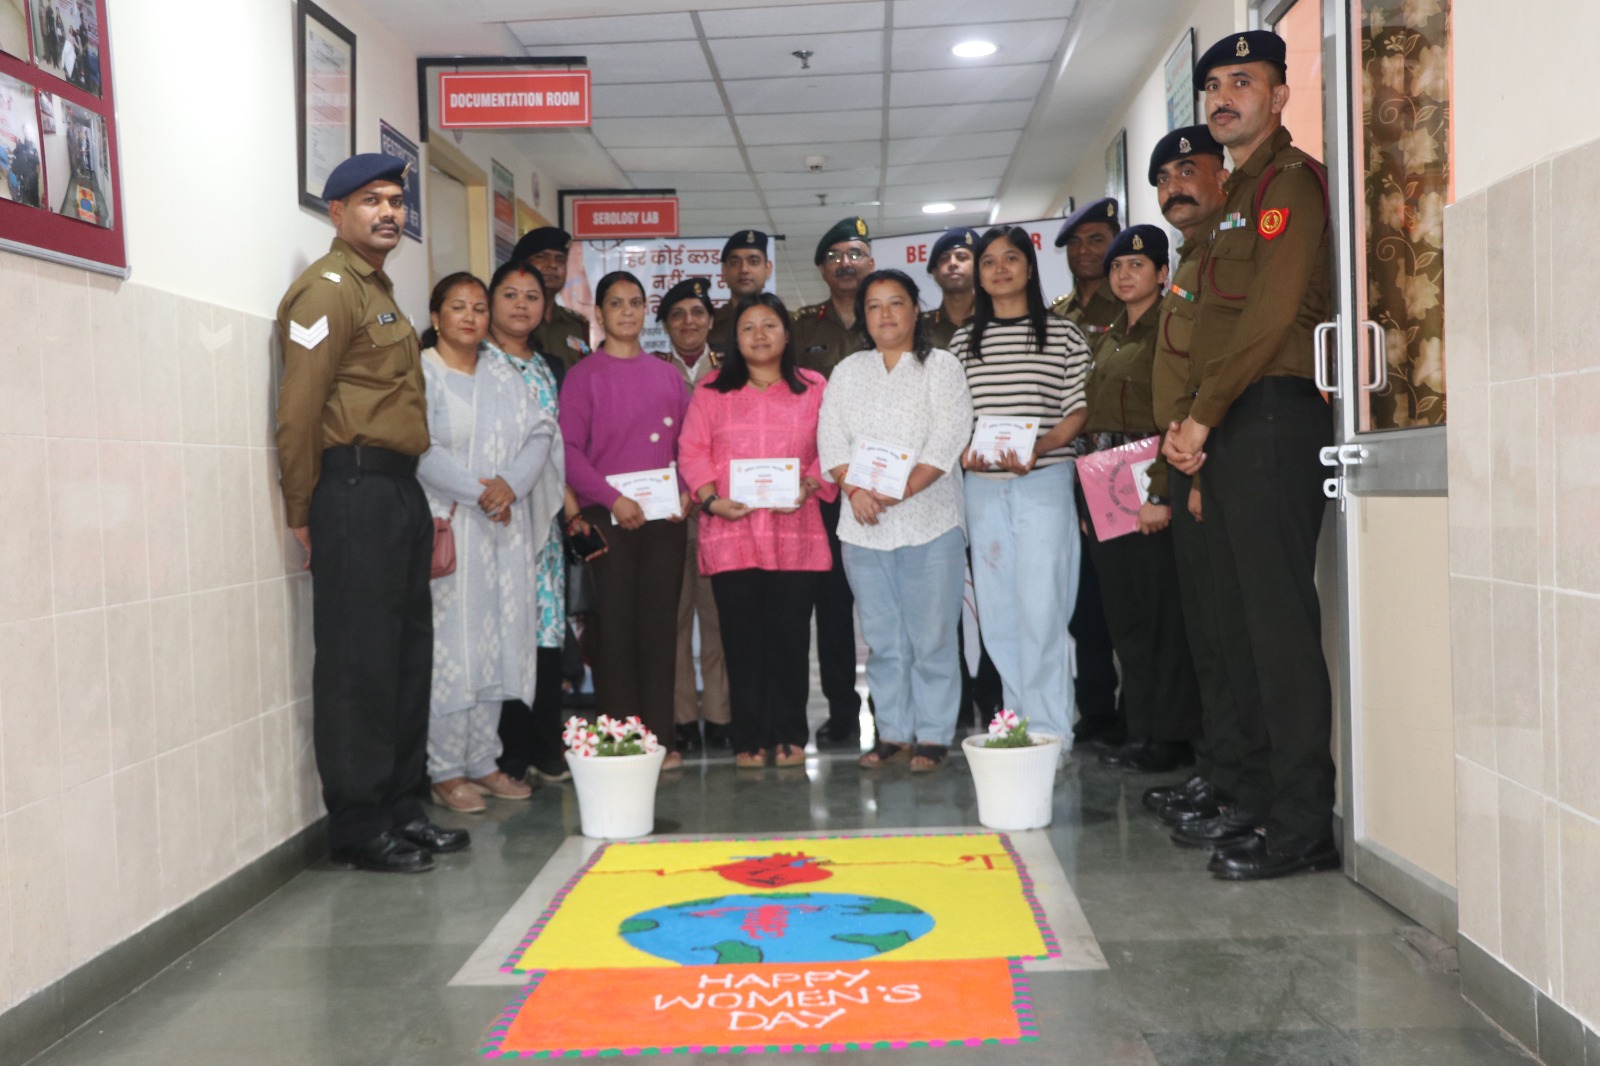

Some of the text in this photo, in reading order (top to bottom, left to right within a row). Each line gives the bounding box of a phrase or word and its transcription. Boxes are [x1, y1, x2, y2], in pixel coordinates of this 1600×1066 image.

[450, 90, 580, 108] DOCUMENTATION ROOM
[592, 211, 659, 225] SEROLOGY LAB
[625, 250, 647, 268] हर
[650, 243, 686, 266] कोई
[906, 244, 927, 264] BE
[699, 968, 871, 989] HAPPY
[653, 983, 922, 1011] WOMEN'S
[728, 1007, 847, 1032] DAY
